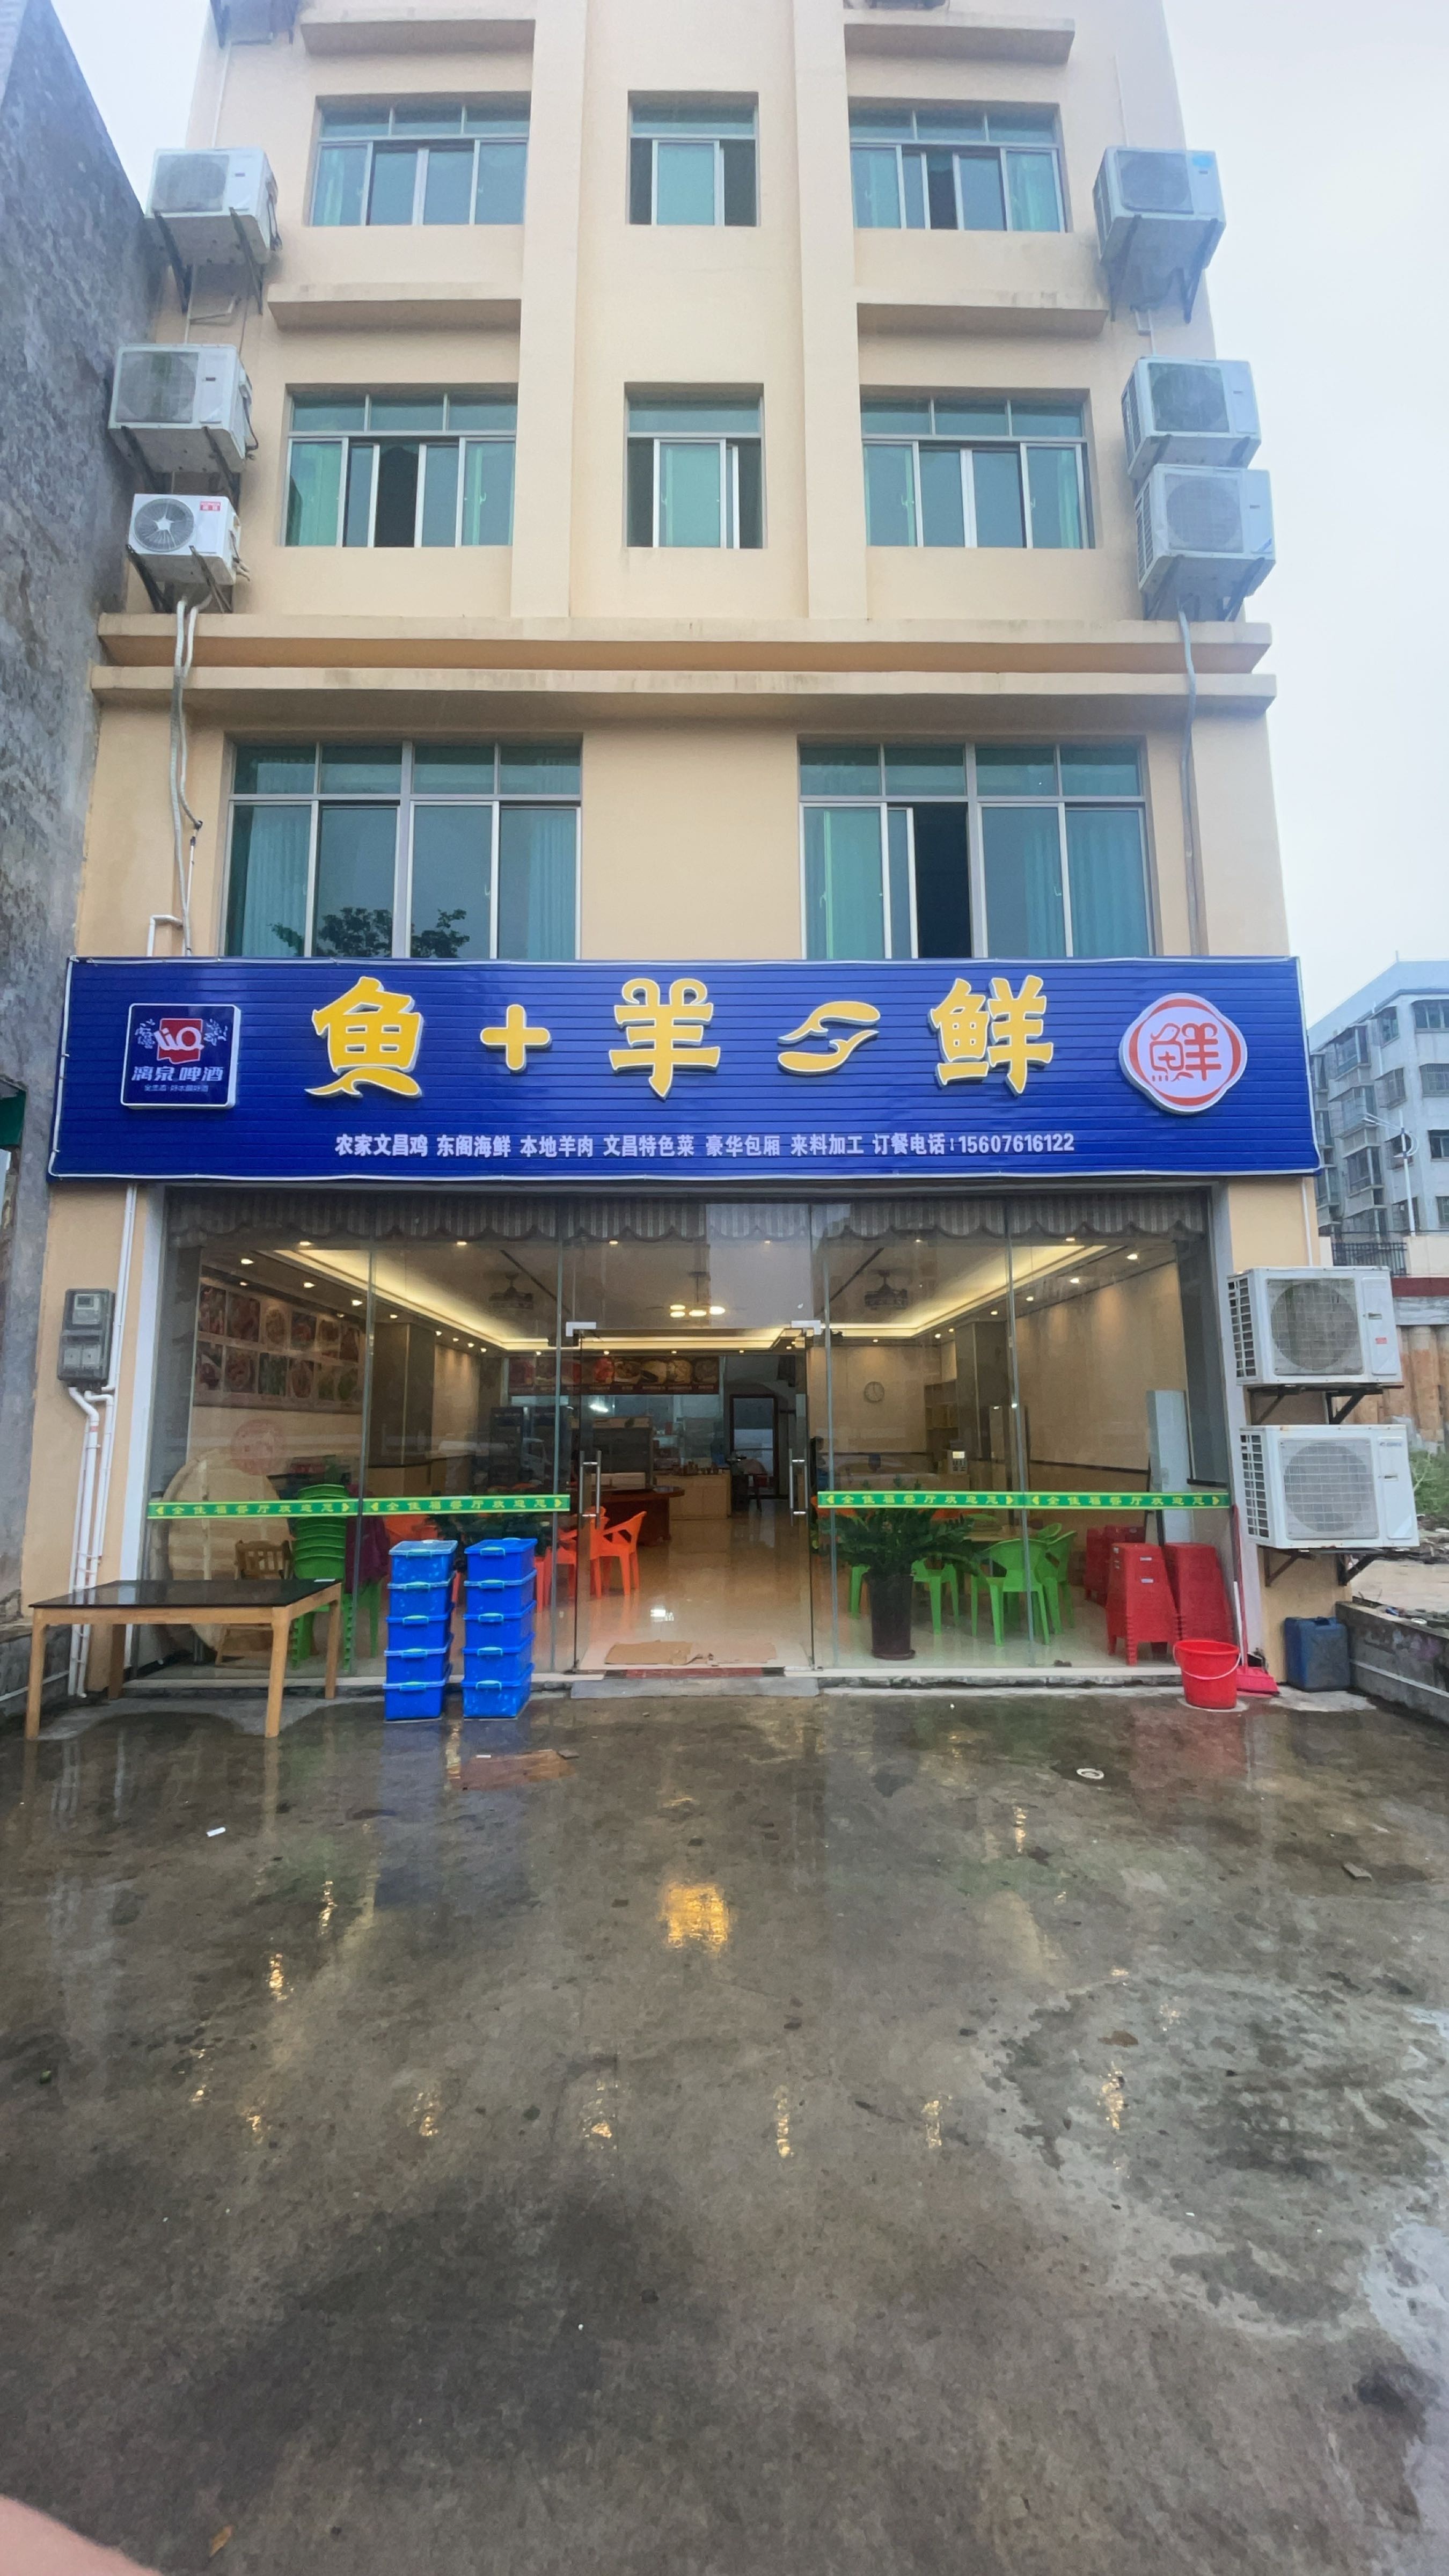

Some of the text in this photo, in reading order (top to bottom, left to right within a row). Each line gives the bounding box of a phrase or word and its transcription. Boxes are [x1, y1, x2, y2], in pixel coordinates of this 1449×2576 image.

[335, 1133, 428, 1157] 农家文昌鸡
[436, 1135, 511, 1158] 东阁海鲜
[520, 1136, 593, 1158] 本地羊肉
[603, 1135, 695, 1157] 文昌特色菜
[706, 1135, 780, 1158] 豪华包厢
[791, 1133, 864, 1157] 来料加工
